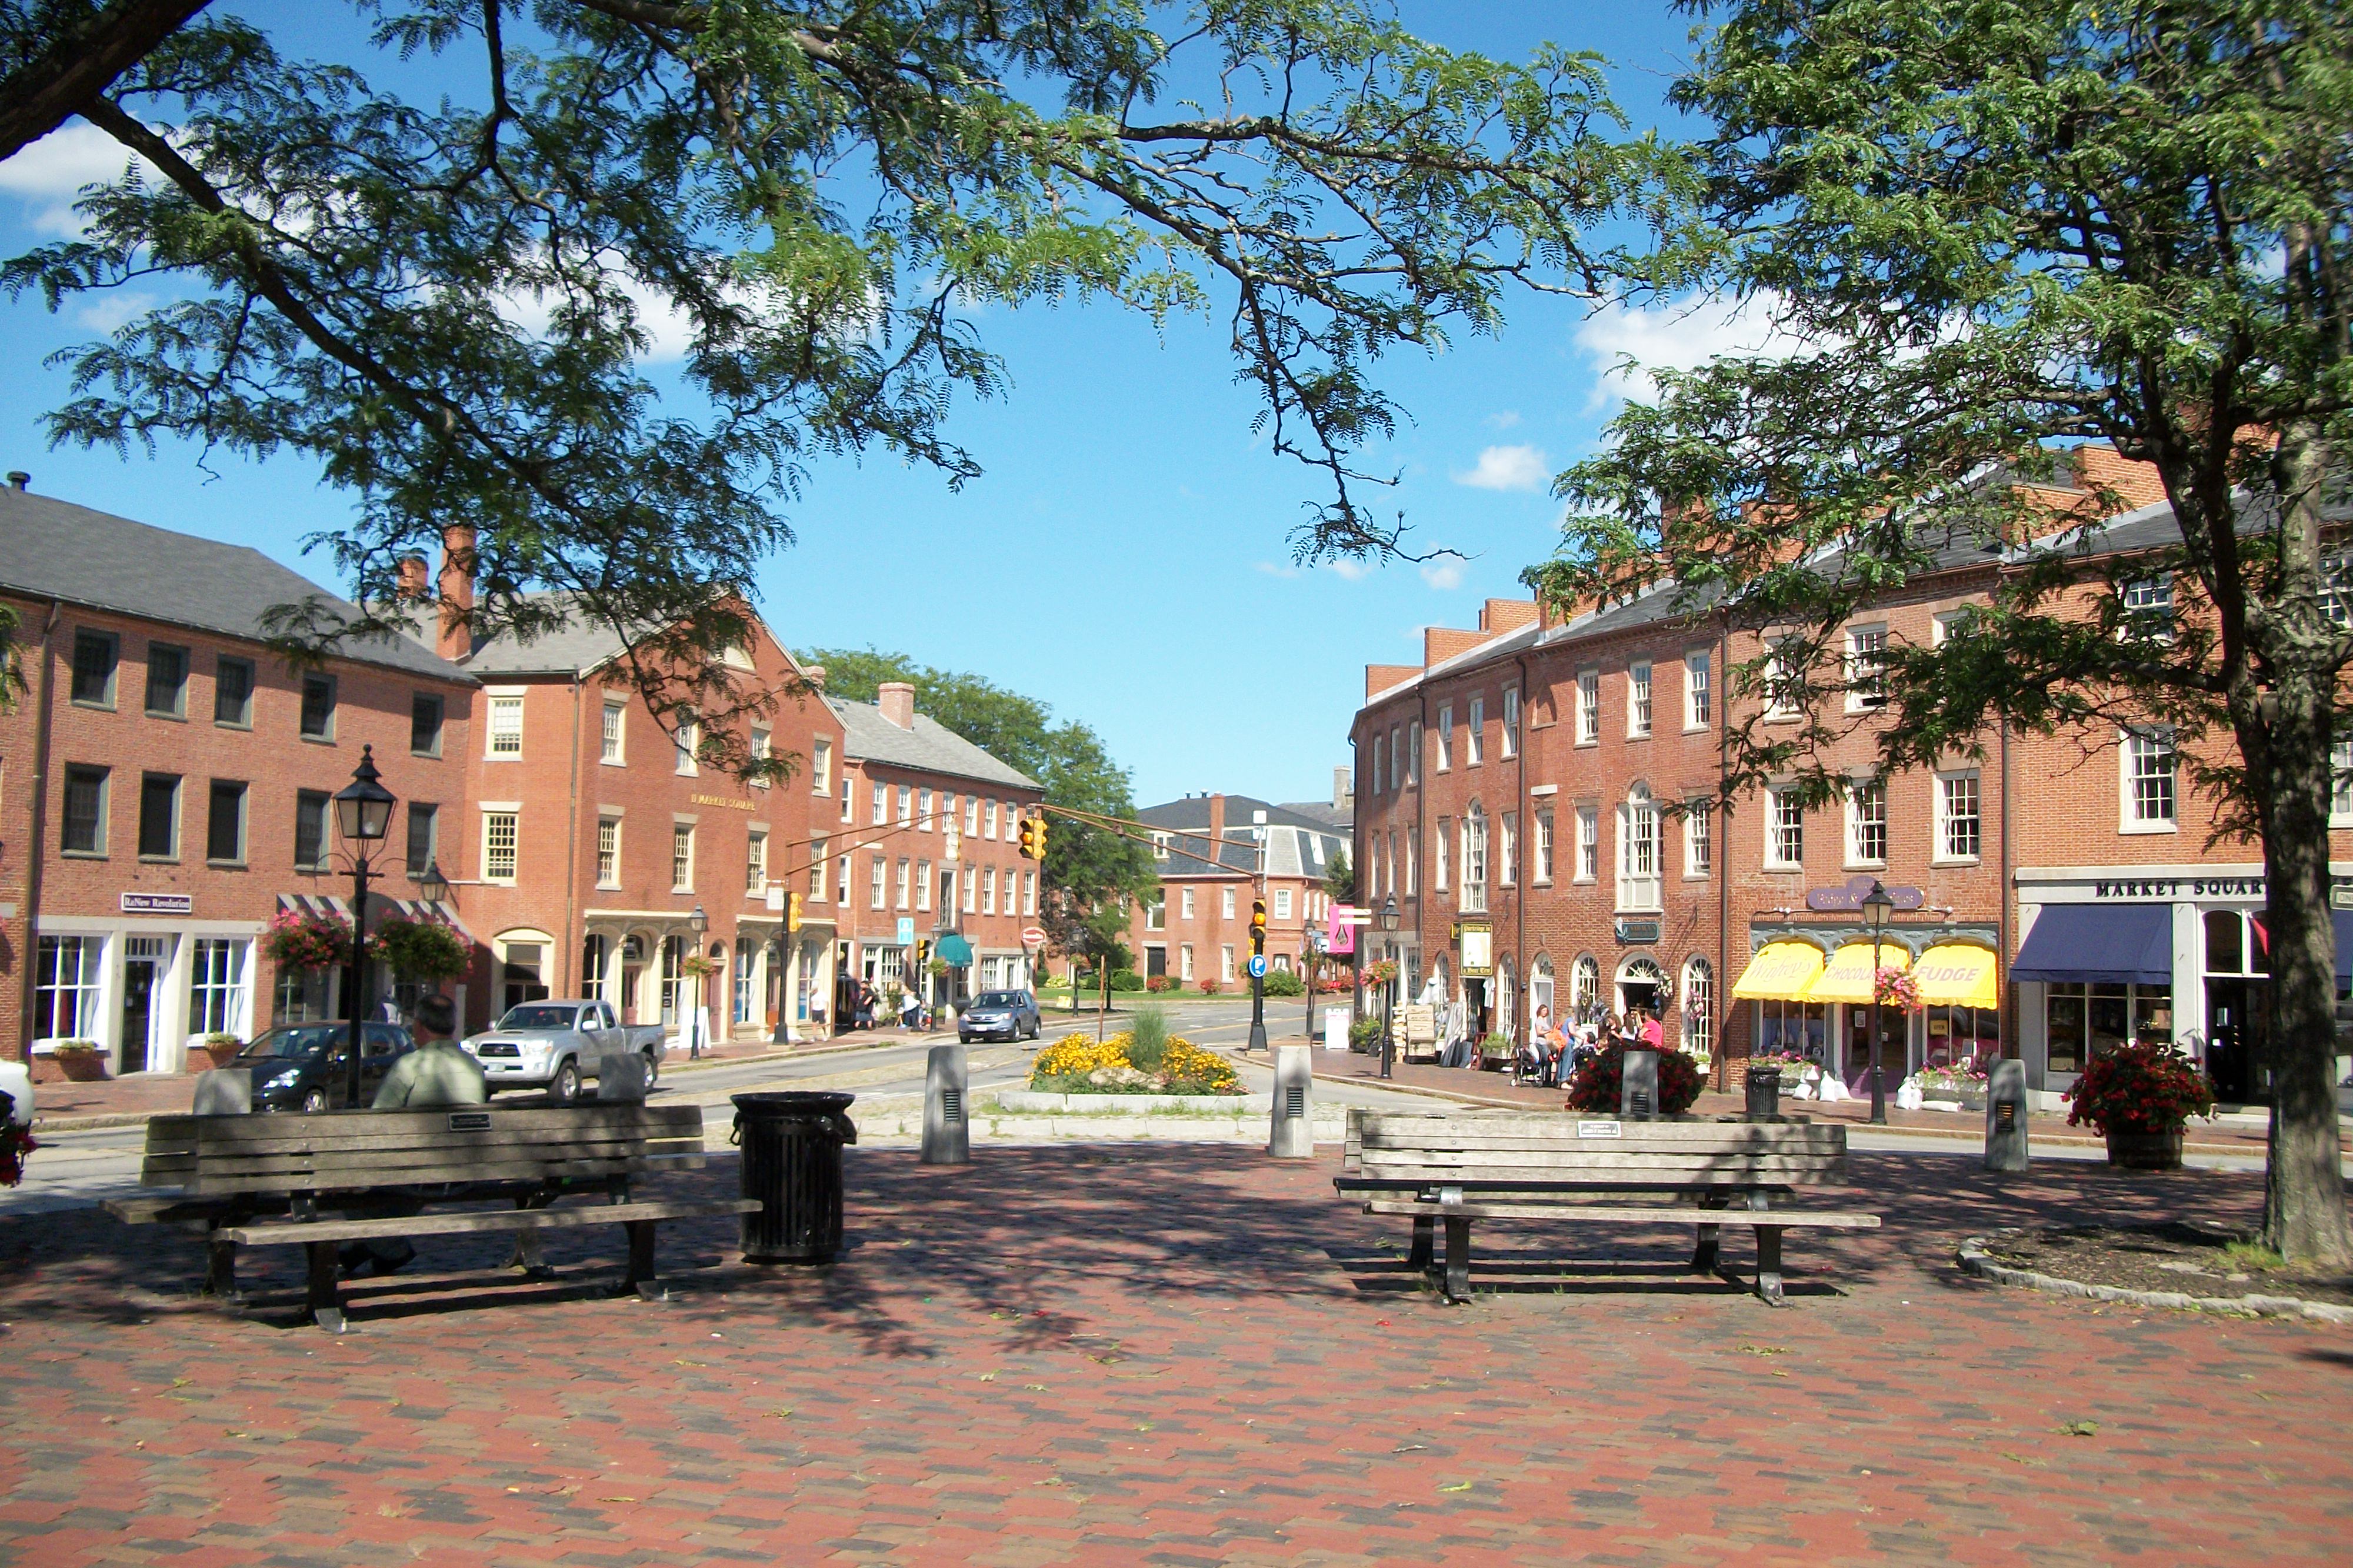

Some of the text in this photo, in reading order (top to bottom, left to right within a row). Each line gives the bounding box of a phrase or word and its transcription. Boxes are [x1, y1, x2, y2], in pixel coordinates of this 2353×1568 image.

[699, 795, 726, 807] MARKET
[729, 799, 755, 811] SQUARE
[2095, 880, 2266, 898] MARKET SQUAR
[152, 898, 189, 908] Revolution
[1255, 958, 1264, 970] P
[1916, 966, 1980, 982] FUDGE
